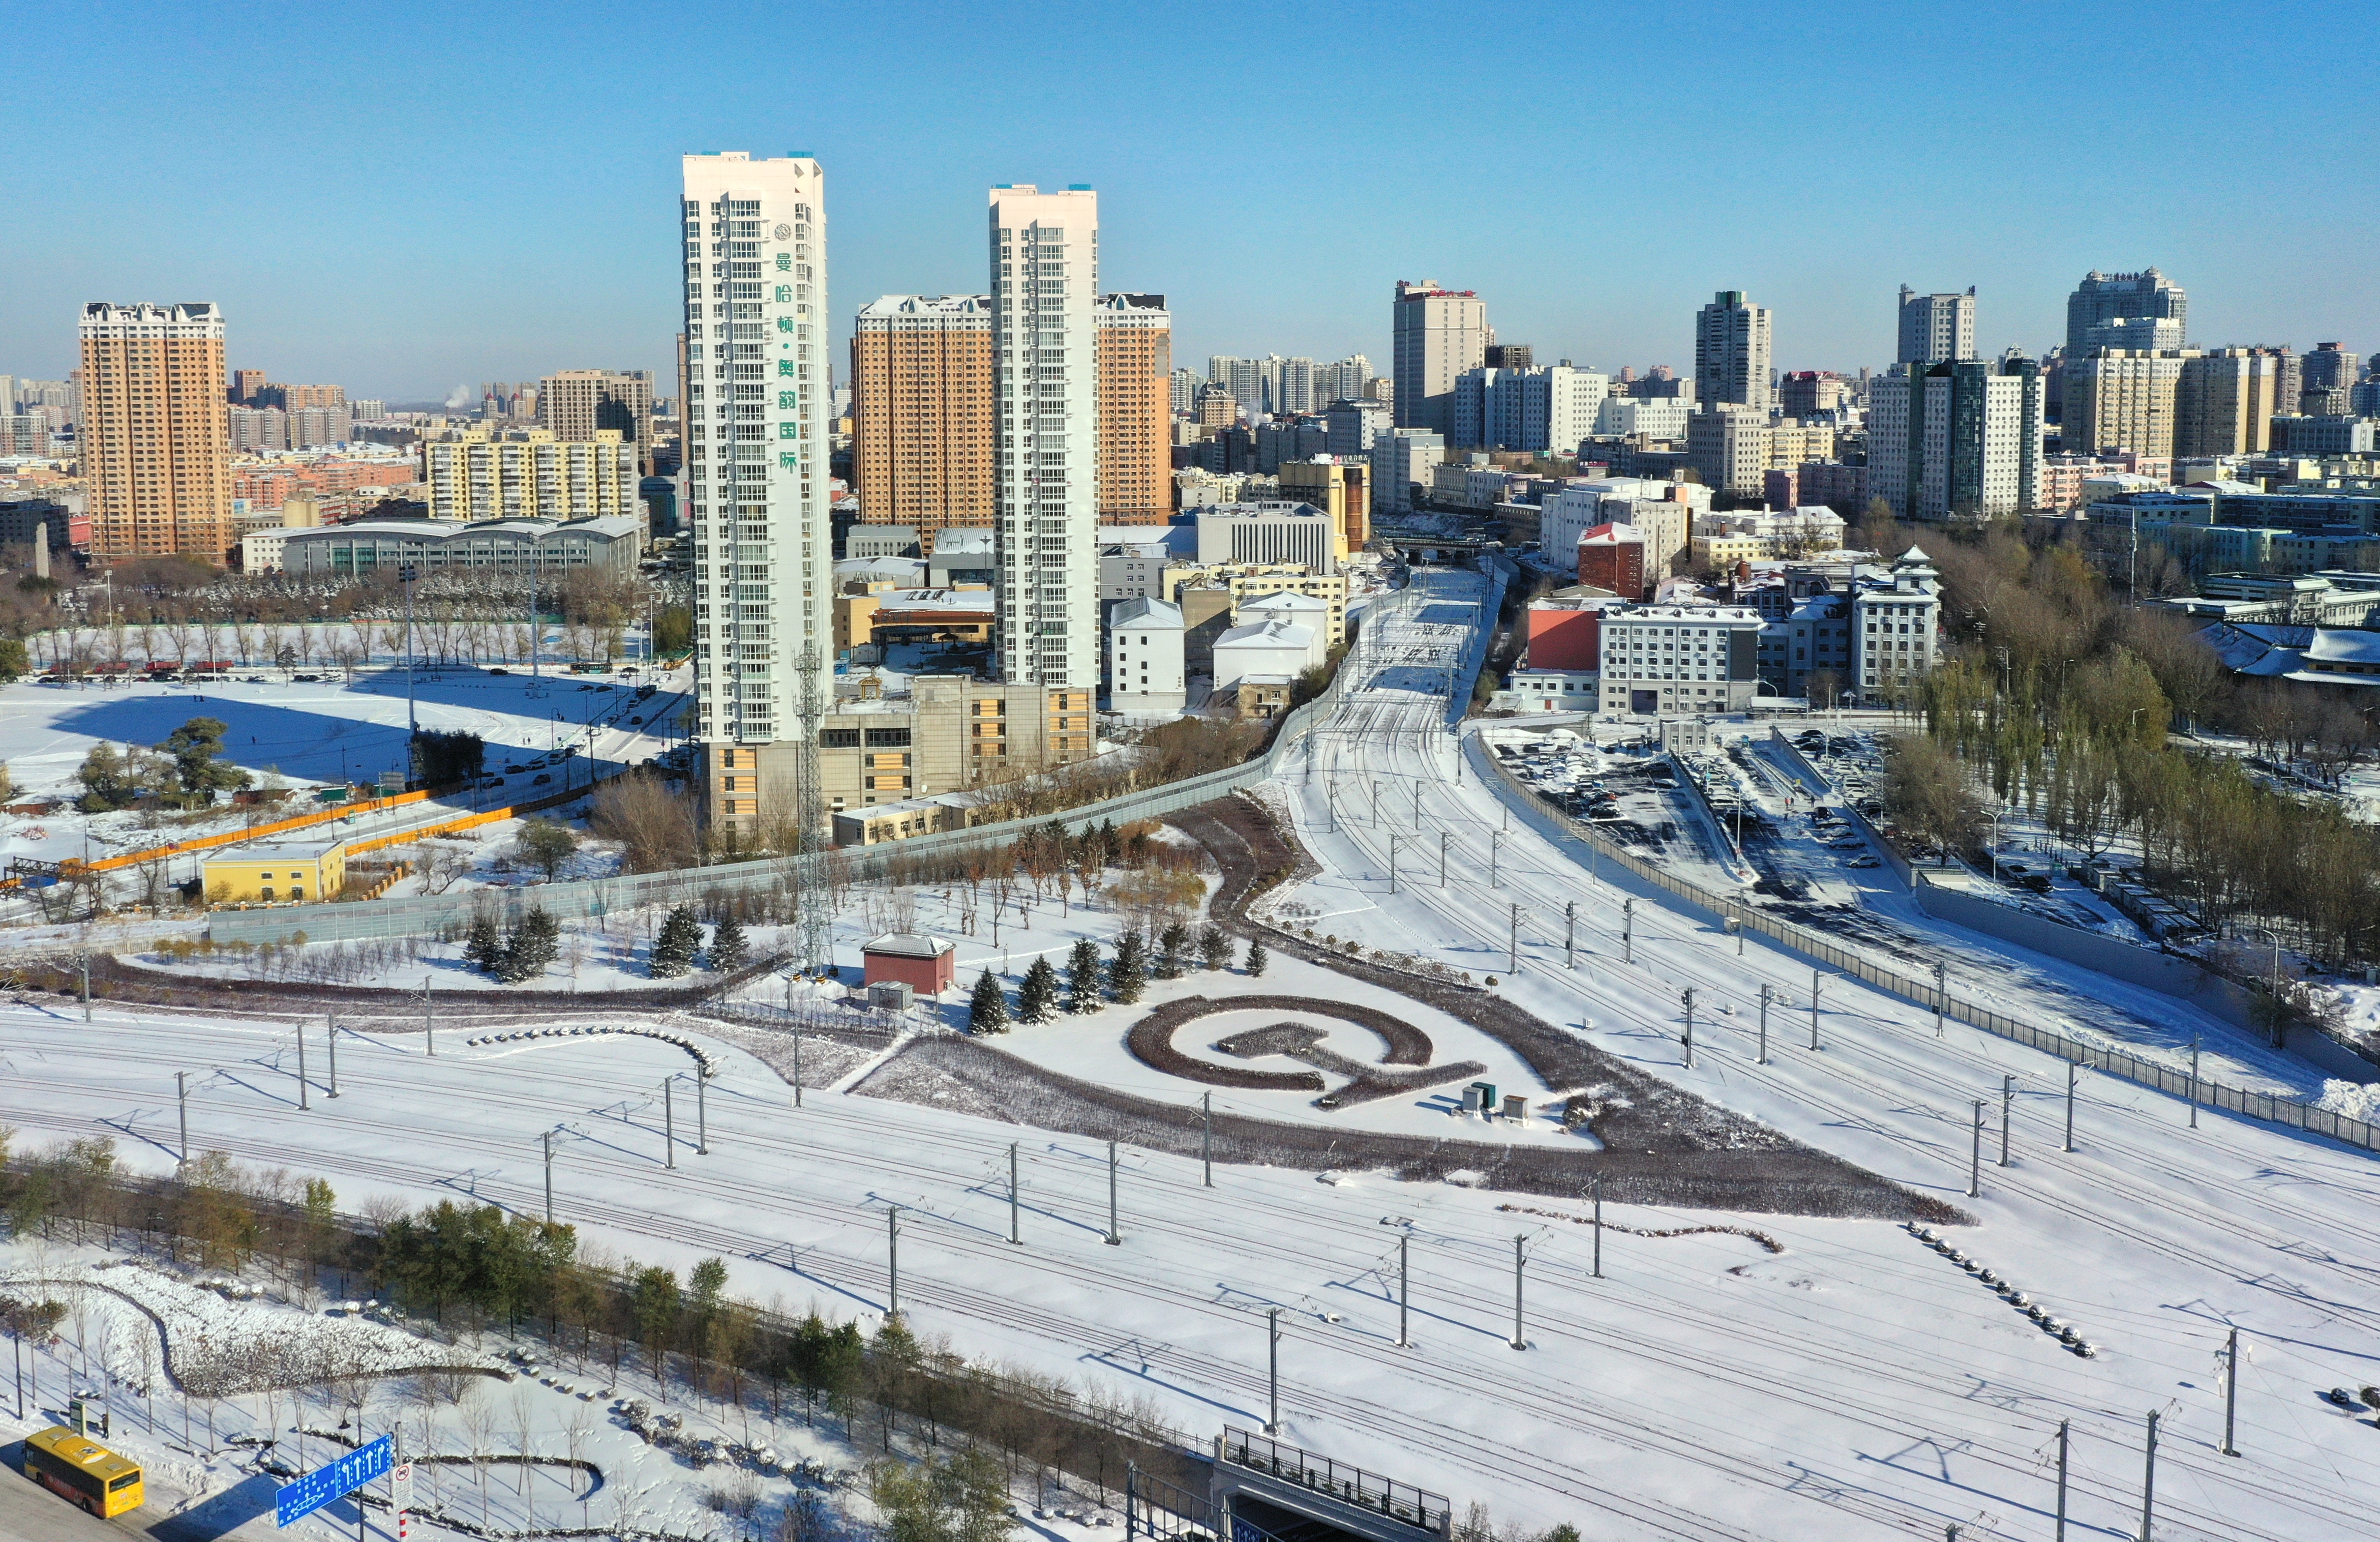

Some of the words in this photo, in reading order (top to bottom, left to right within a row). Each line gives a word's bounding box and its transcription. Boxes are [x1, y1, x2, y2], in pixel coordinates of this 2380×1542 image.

[775, 253, 797, 473] 曼哈顿·奥韵国际
